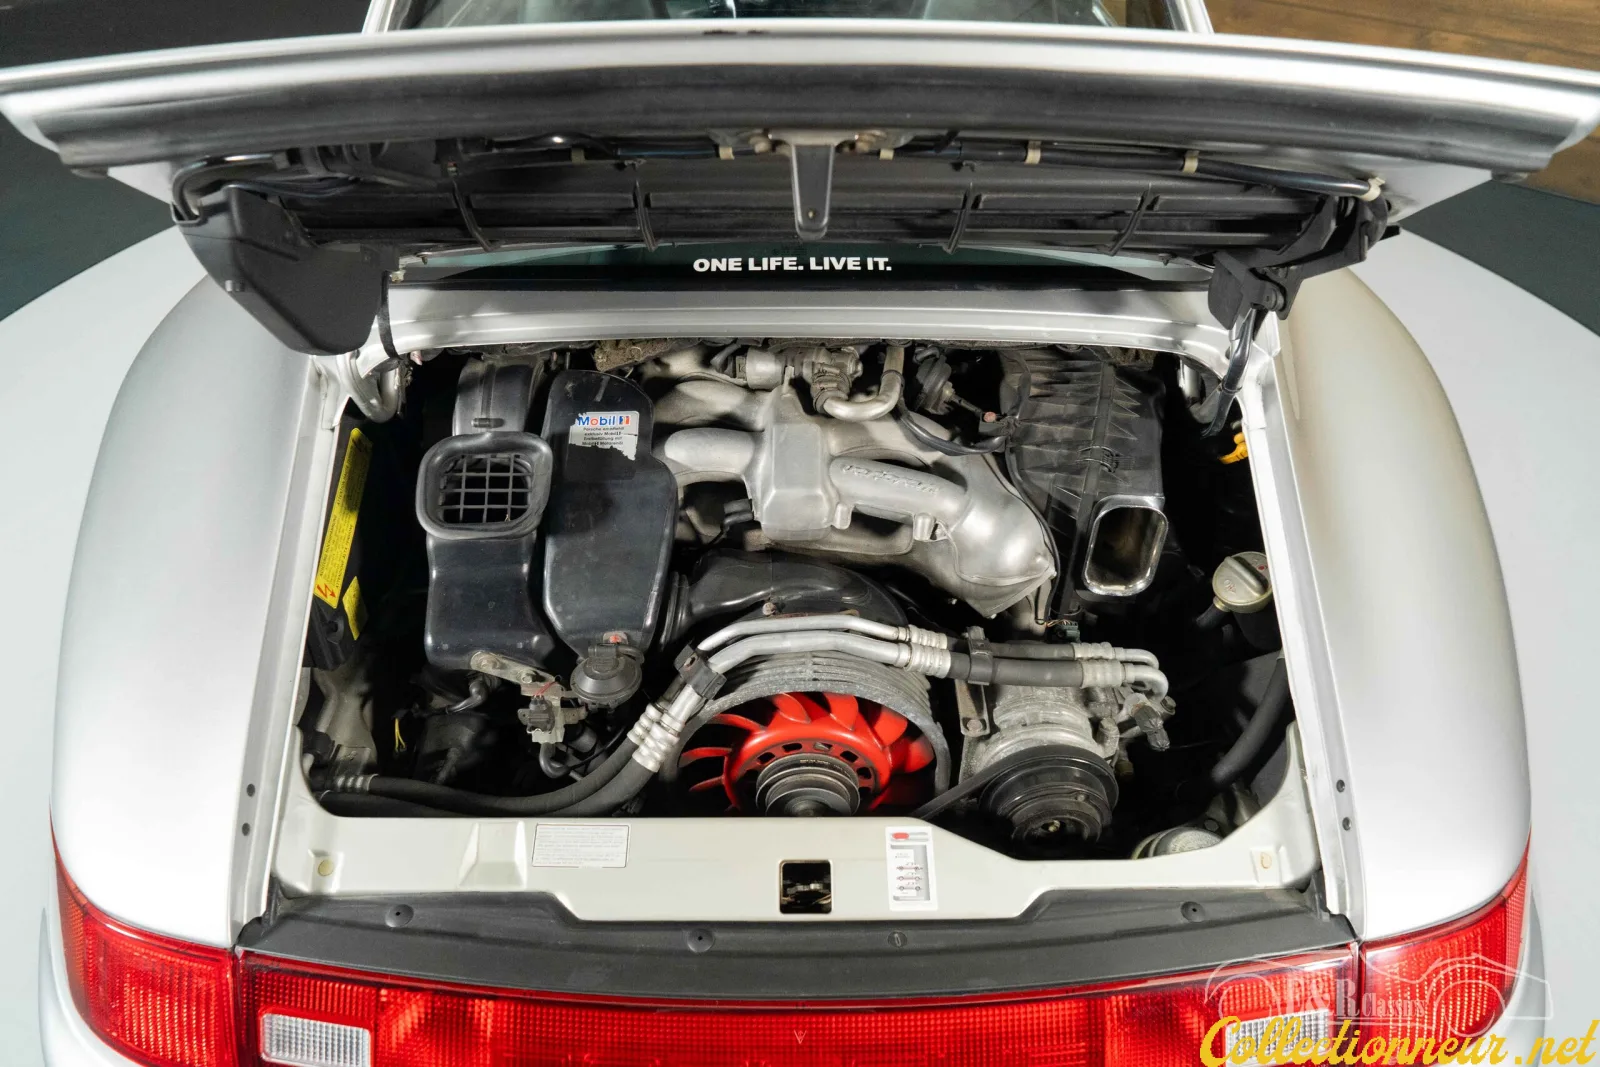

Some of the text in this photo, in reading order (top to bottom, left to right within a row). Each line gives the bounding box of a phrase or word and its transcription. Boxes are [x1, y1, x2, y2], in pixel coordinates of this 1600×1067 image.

[693, 256, 892, 272] ONE LIFE. LIVE IT.
[577, 416, 615, 426] Mobil
